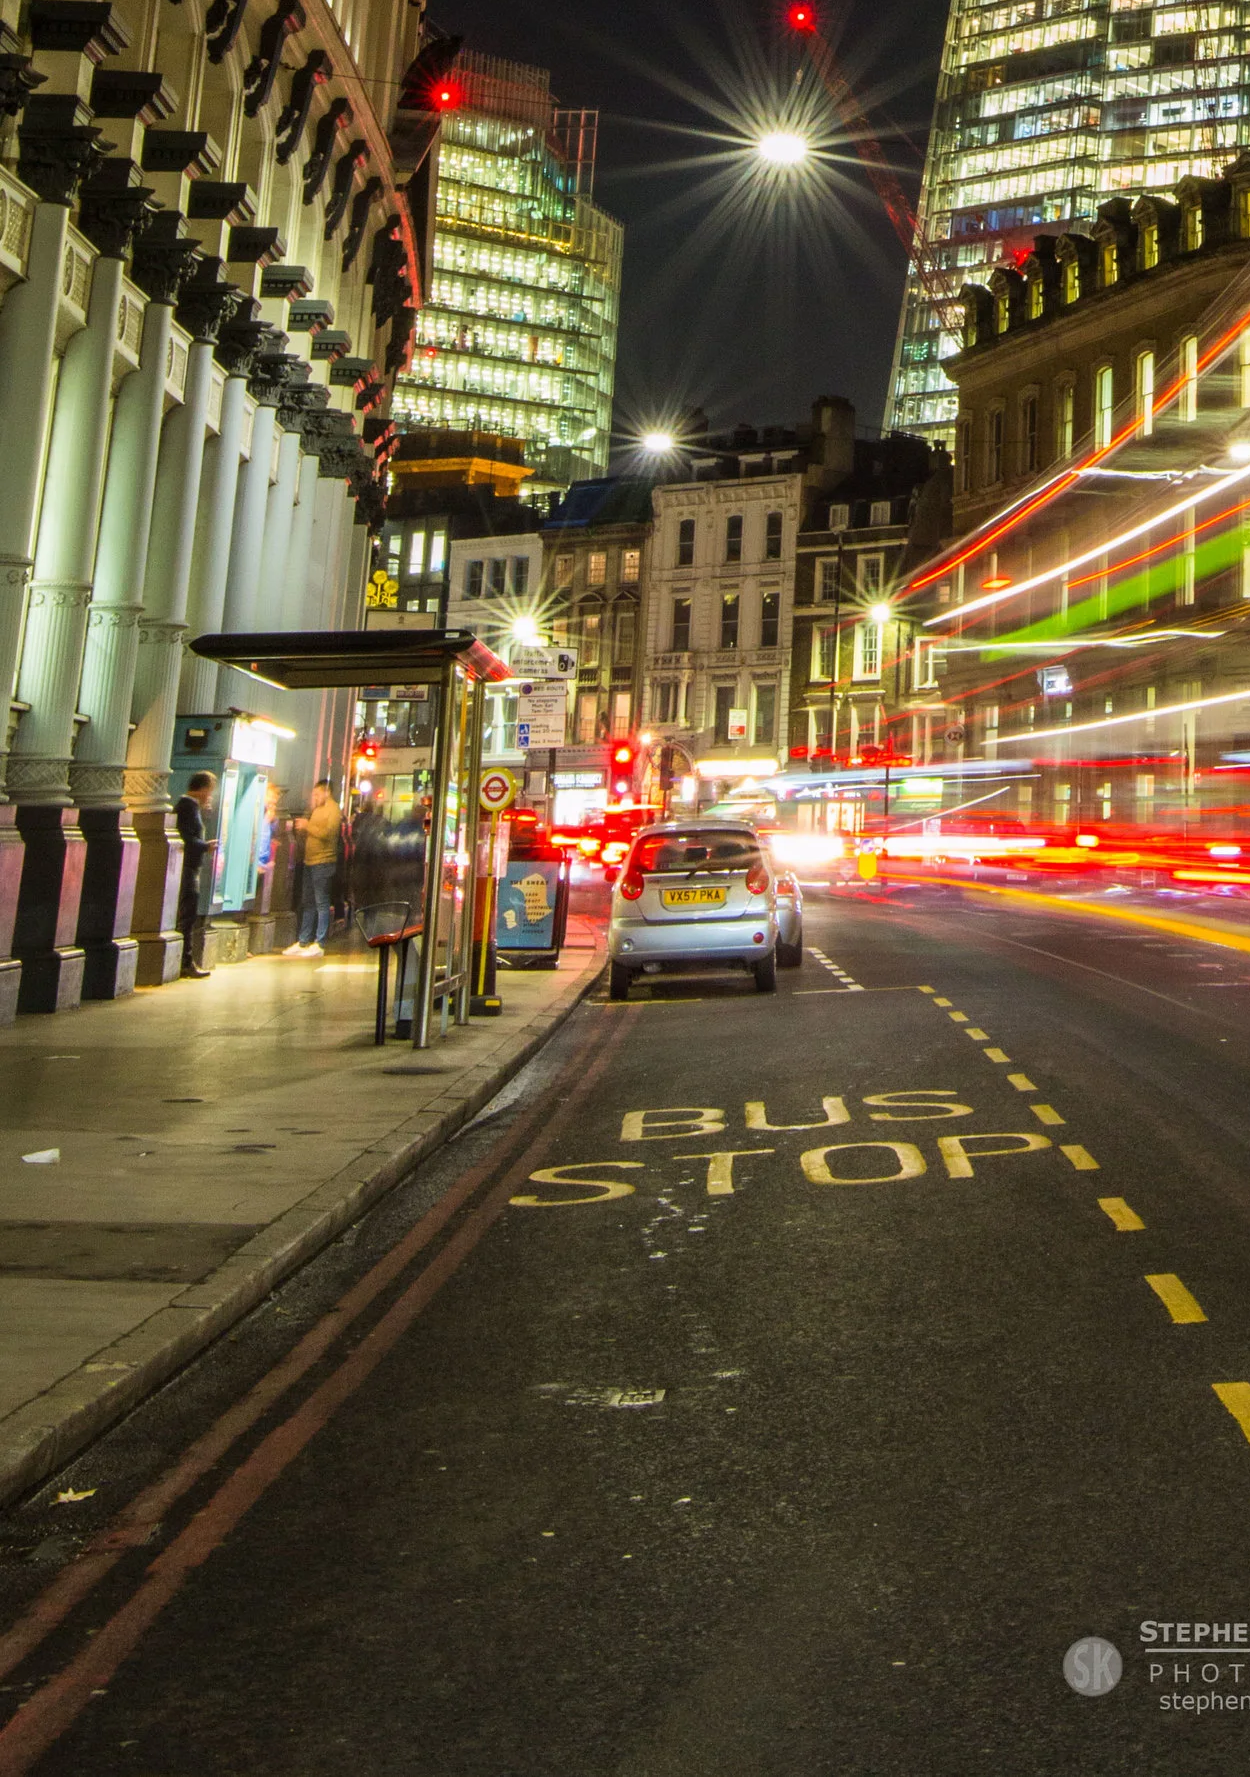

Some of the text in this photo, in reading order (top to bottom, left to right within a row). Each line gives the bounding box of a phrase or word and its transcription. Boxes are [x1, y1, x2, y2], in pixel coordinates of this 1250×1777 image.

[669, 889, 721, 902] VX57 PKA
[620, 1091, 974, 1142] BUS
[509, 1132, 1053, 1206] STOP
